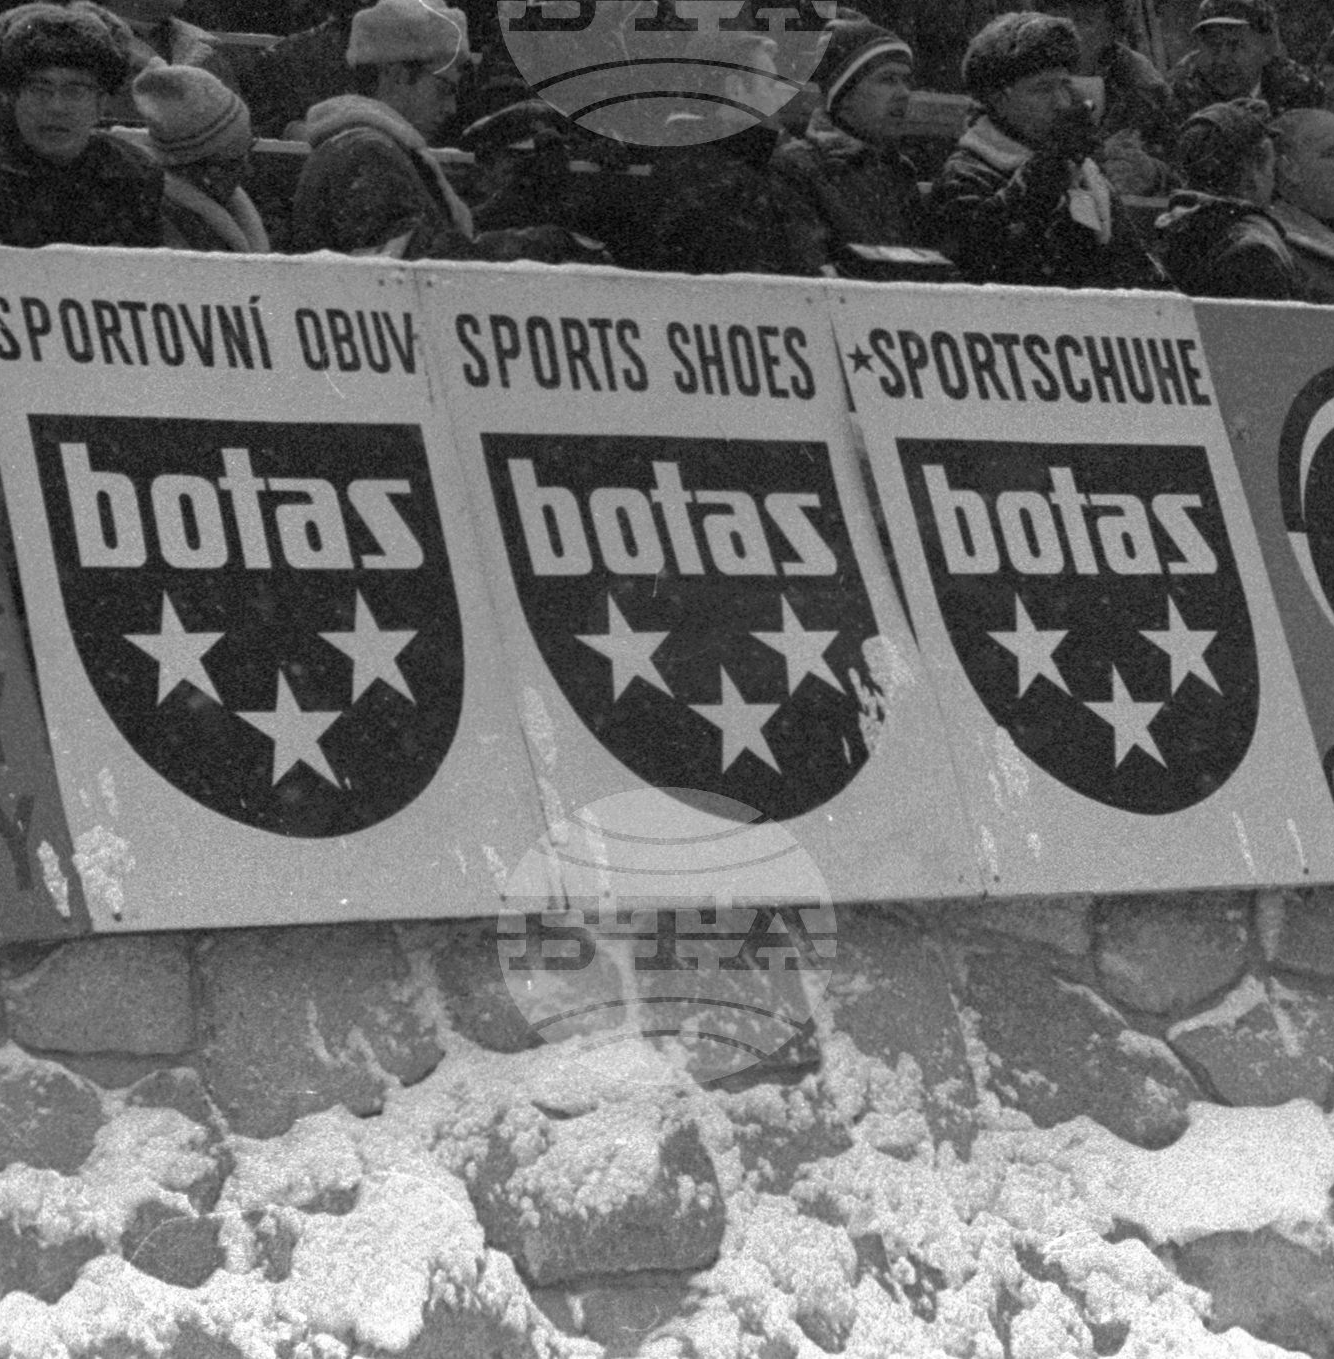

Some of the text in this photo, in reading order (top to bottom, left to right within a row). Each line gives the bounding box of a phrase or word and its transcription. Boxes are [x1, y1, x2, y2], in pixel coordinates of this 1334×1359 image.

[294, 307, 418, 375] OBUV
[455, 313, 816, 400] SPORTS SHOES
[867, 327, 1212, 406] SPORTSCHUHE
[59, 442, 424, 570] botas
[507, 458, 838, 577] botas
[921, 463, 1219, 576] botas
